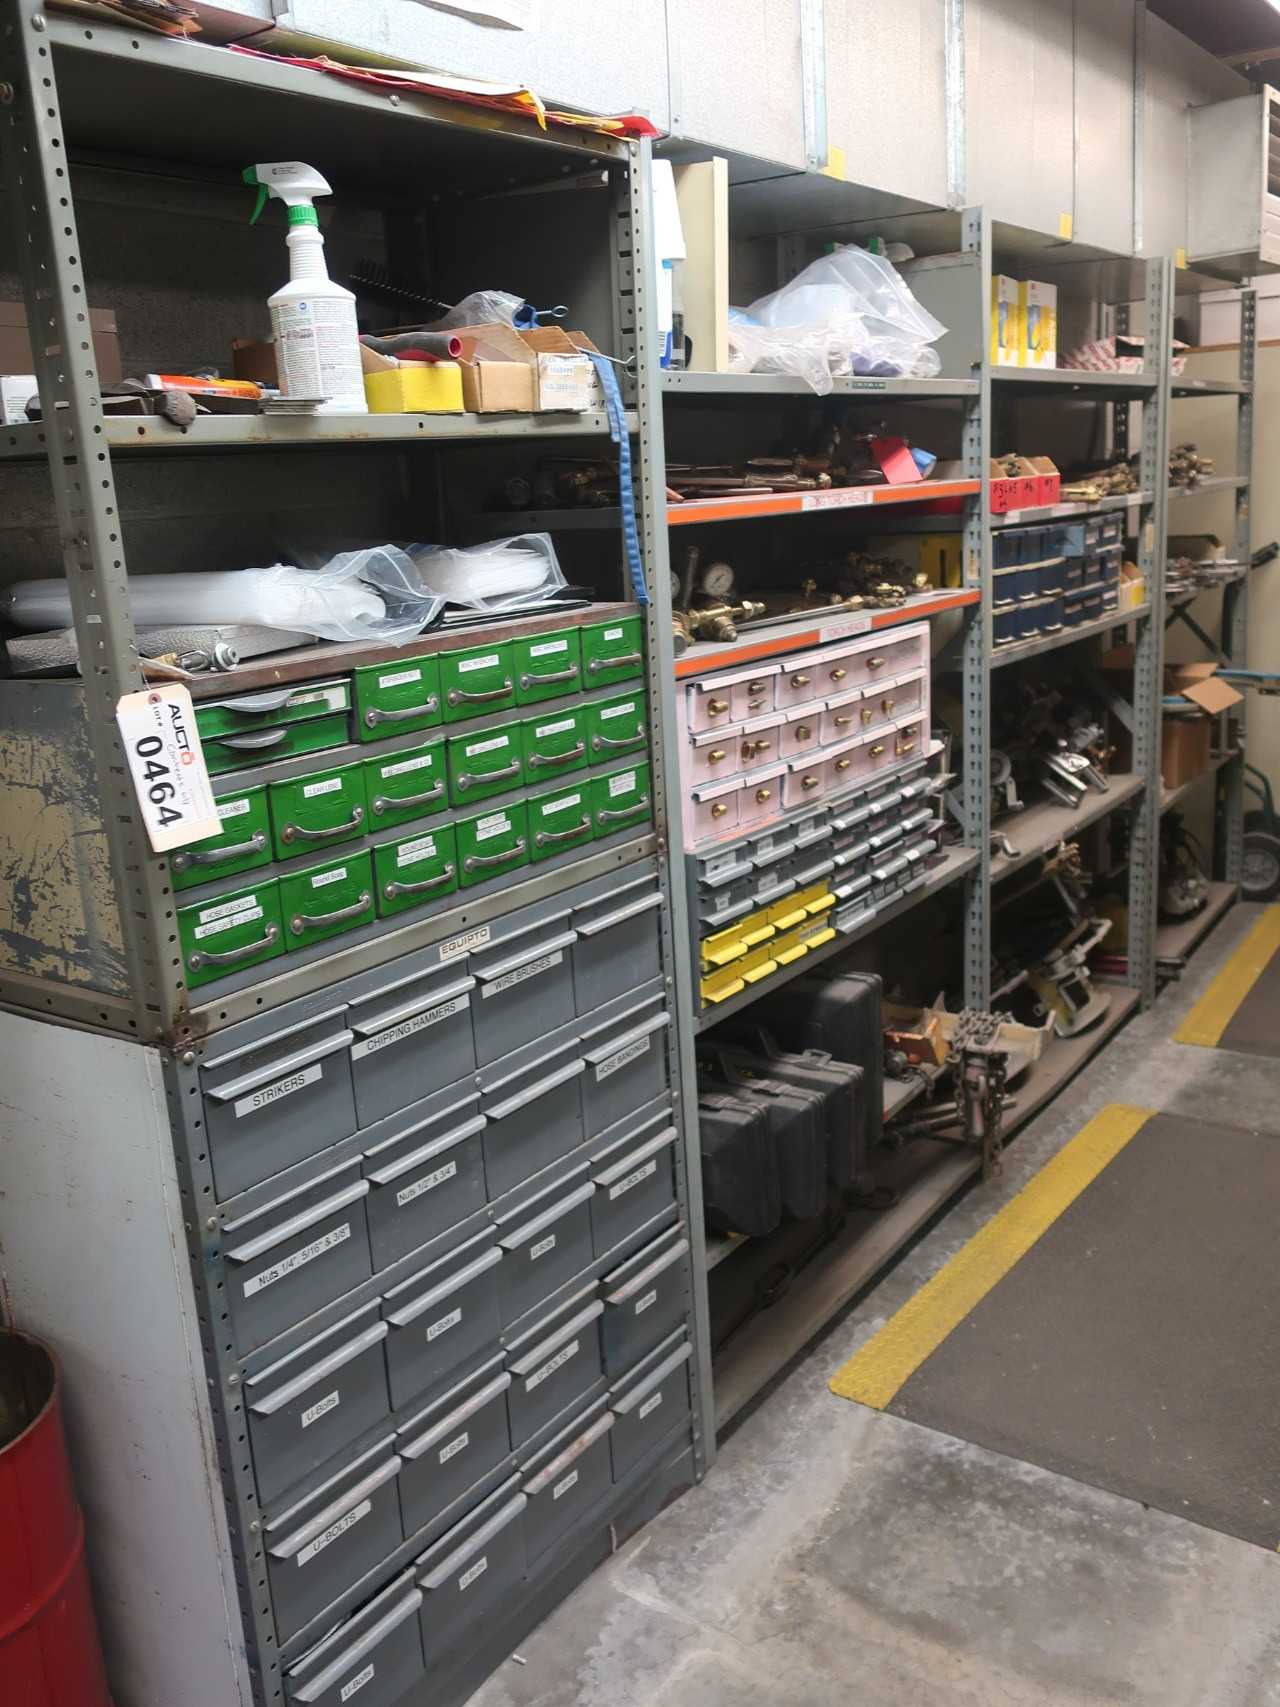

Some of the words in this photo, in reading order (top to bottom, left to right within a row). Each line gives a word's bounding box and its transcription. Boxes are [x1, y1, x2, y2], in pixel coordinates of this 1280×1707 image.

[136, 735, 183, 828] 0464
[206, 908, 225, 921] HOSE
[226, 900, 254, 915] GASKETS
[441, 930, 488, 955] EQUIPTO
[494, 974, 515, 991] WIRE
[516, 957, 551, 980] BRUSHES
[366, 1022, 411, 1050] CHIPPING
[412, 1001, 456, 1030] HAMMERS
[252, 1073, 305, 1107] STRIKERS
[399, 1186, 416, 1202] Nuts
[258, 1270, 279, 1287] Nuts
[301, 1240, 324, 1262] 5/16"
[324, 1235, 332, 1248] &
[333, 1225, 349, 1240] 3/8"
[306, 1397, 336, 1422] U-Bolts
[313, 1511, 357, 1552] U-BOLTS
[343, 1669, 372, 1697] U-Bolts
